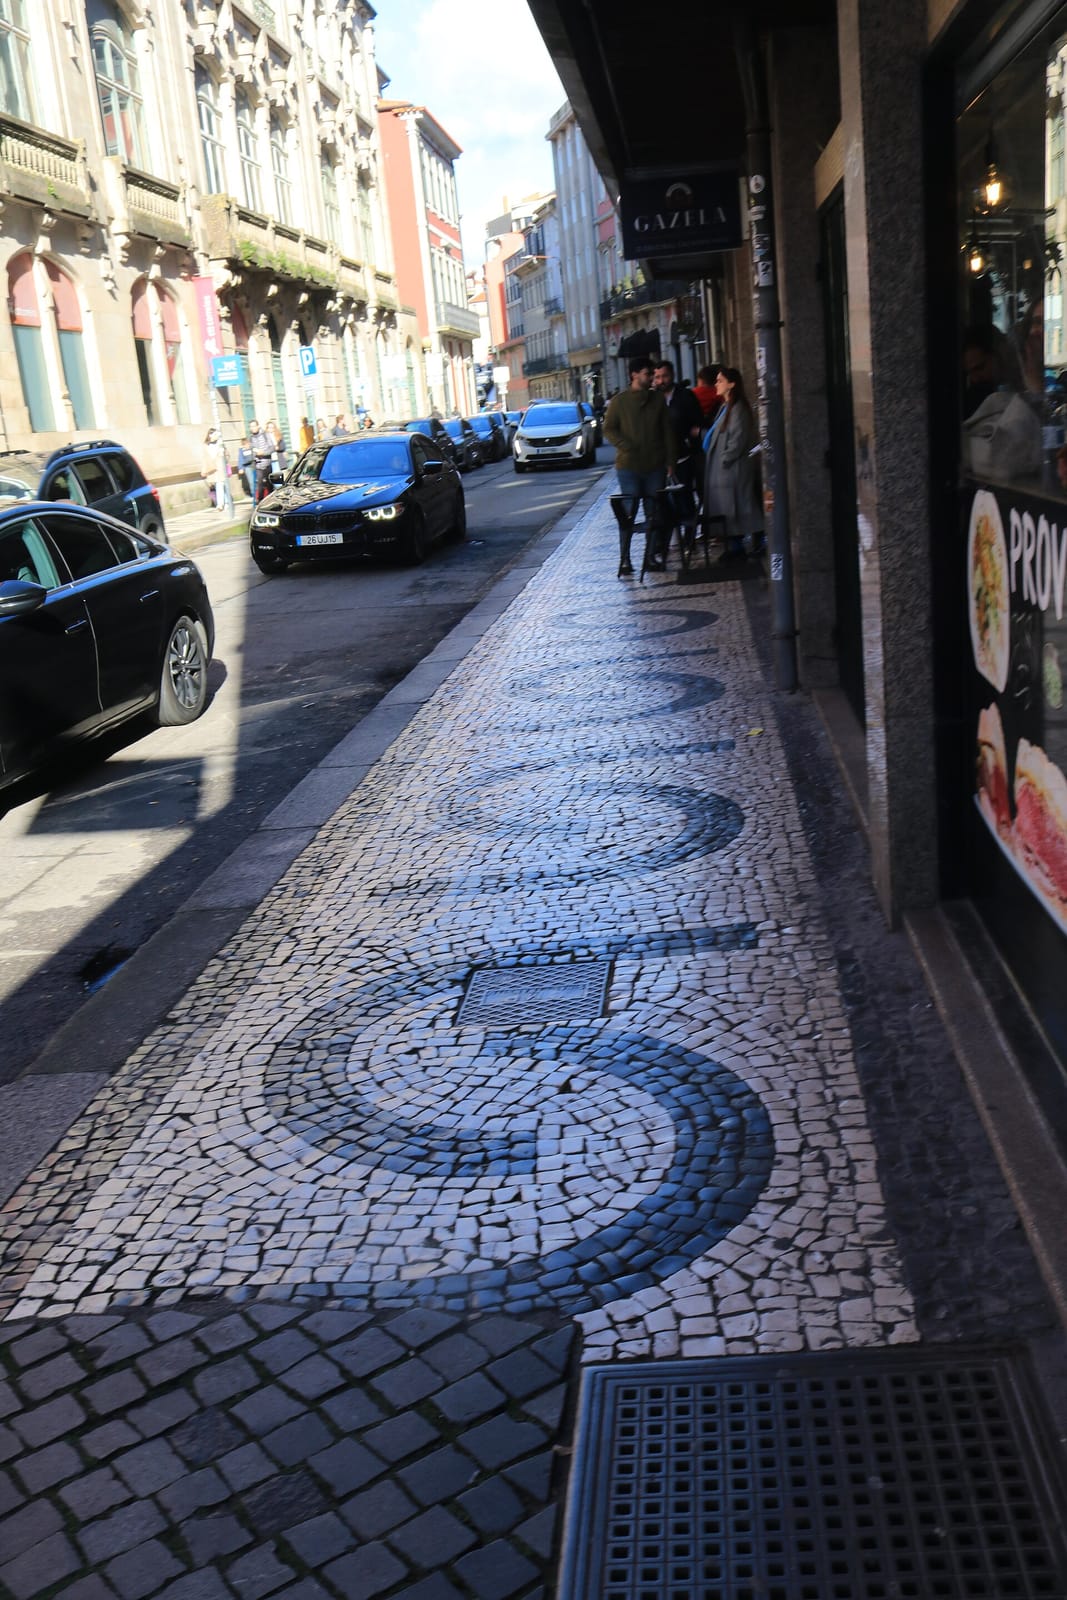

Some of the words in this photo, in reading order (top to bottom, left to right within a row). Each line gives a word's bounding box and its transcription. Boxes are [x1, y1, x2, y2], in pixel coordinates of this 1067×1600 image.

[633, 206, 727, 232] GAZELA
[301, 350, 314, 374] P
[1009, 507, 1067, 620] PROV
